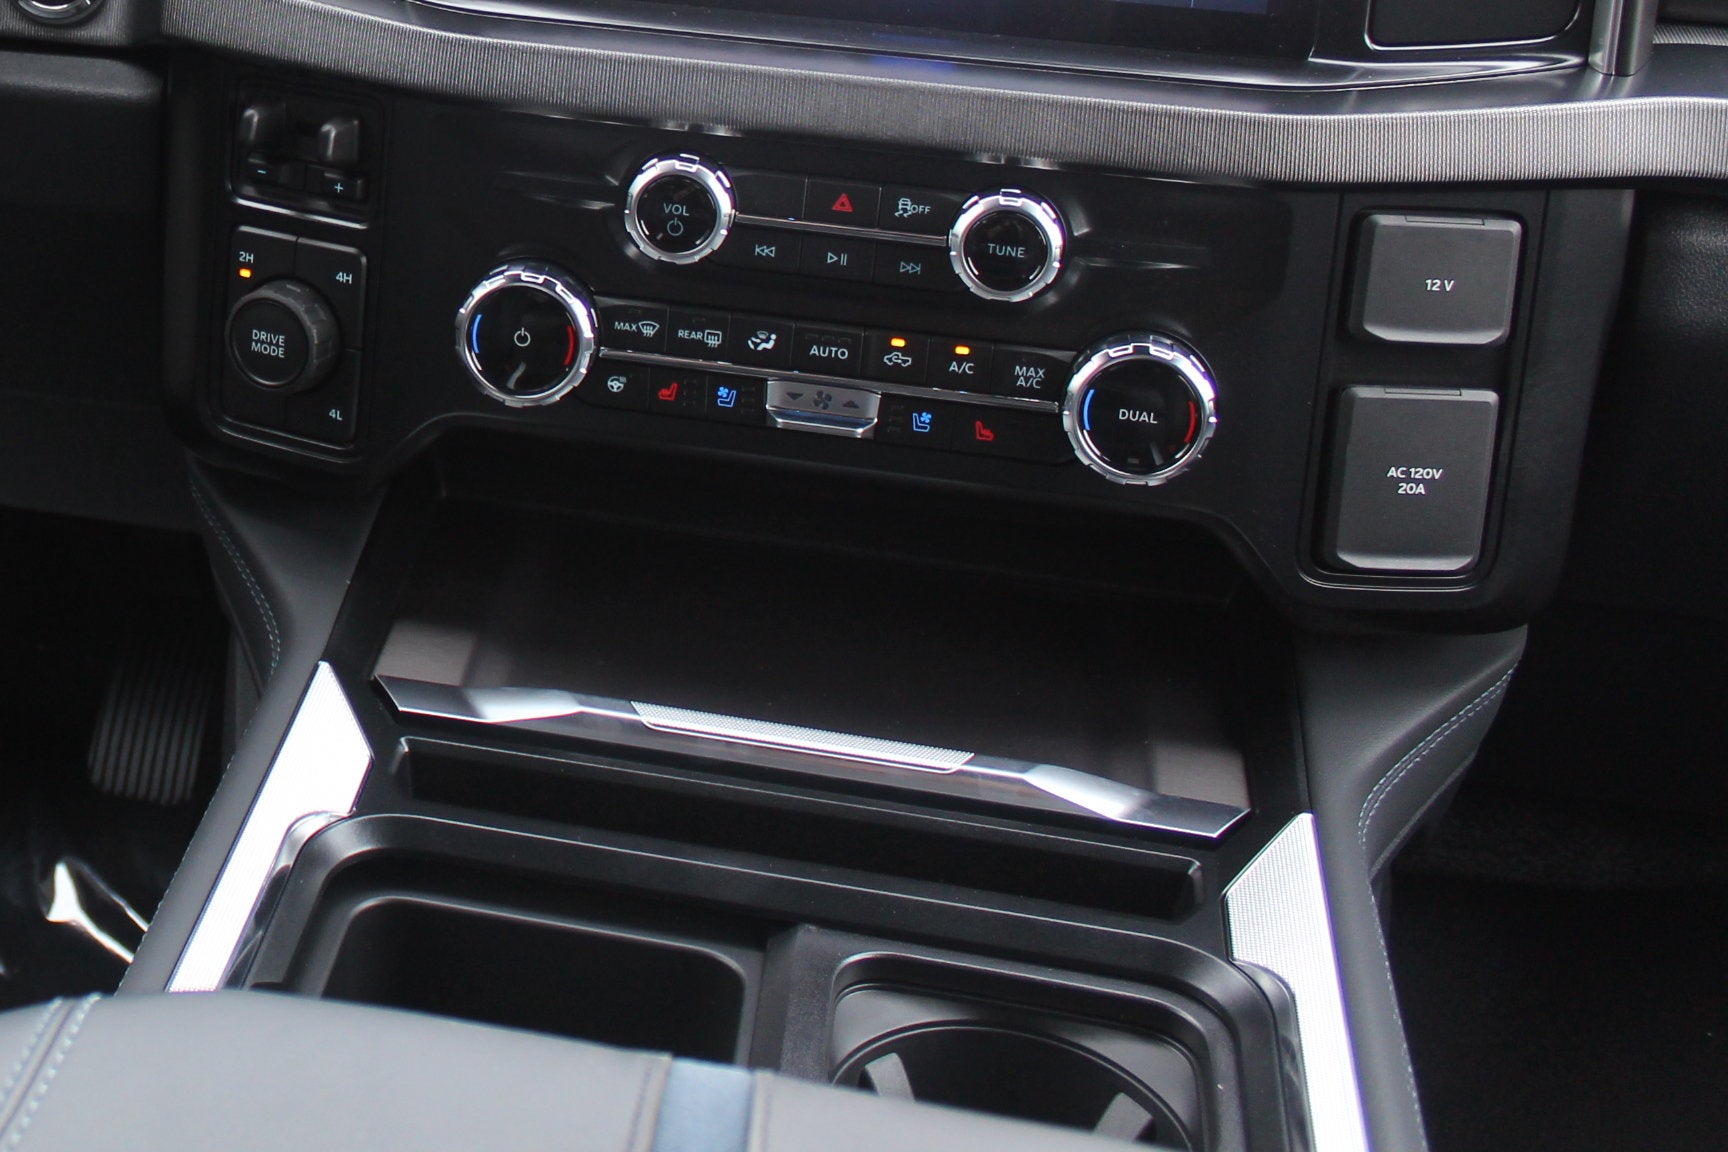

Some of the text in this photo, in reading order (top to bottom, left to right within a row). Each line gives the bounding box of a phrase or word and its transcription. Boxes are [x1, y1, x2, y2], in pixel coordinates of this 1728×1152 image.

[663, 202, 690, 217] VOL
[910, 203, 932, 215] OFF
[987, 243, 1025, 258] TUNE
[238, 251, 255, 265] 2H
[335, 270, 353, 285] 4H
[1425, 278, 1455, 292] 12 V
[614, 321, 638, 333] MAX
[251, 329, 286, 347] DRIVE
[677, 329, 703, 341] REAR
[251, 342, 285, 358] MODE
[808, 344, 849, 360] AUTO
[948, 360, 974, 375] A/C
[1014, 364, 1046, 379] MAX
[1016, 375, 1042, 389] A/C
[328, 408, 343, 421] 4L
[1118, 407, 1158, 424] DUAL
[1386, 466, 1443, 480] AC 120V
[1397, 482, 1426, 495] 20A
